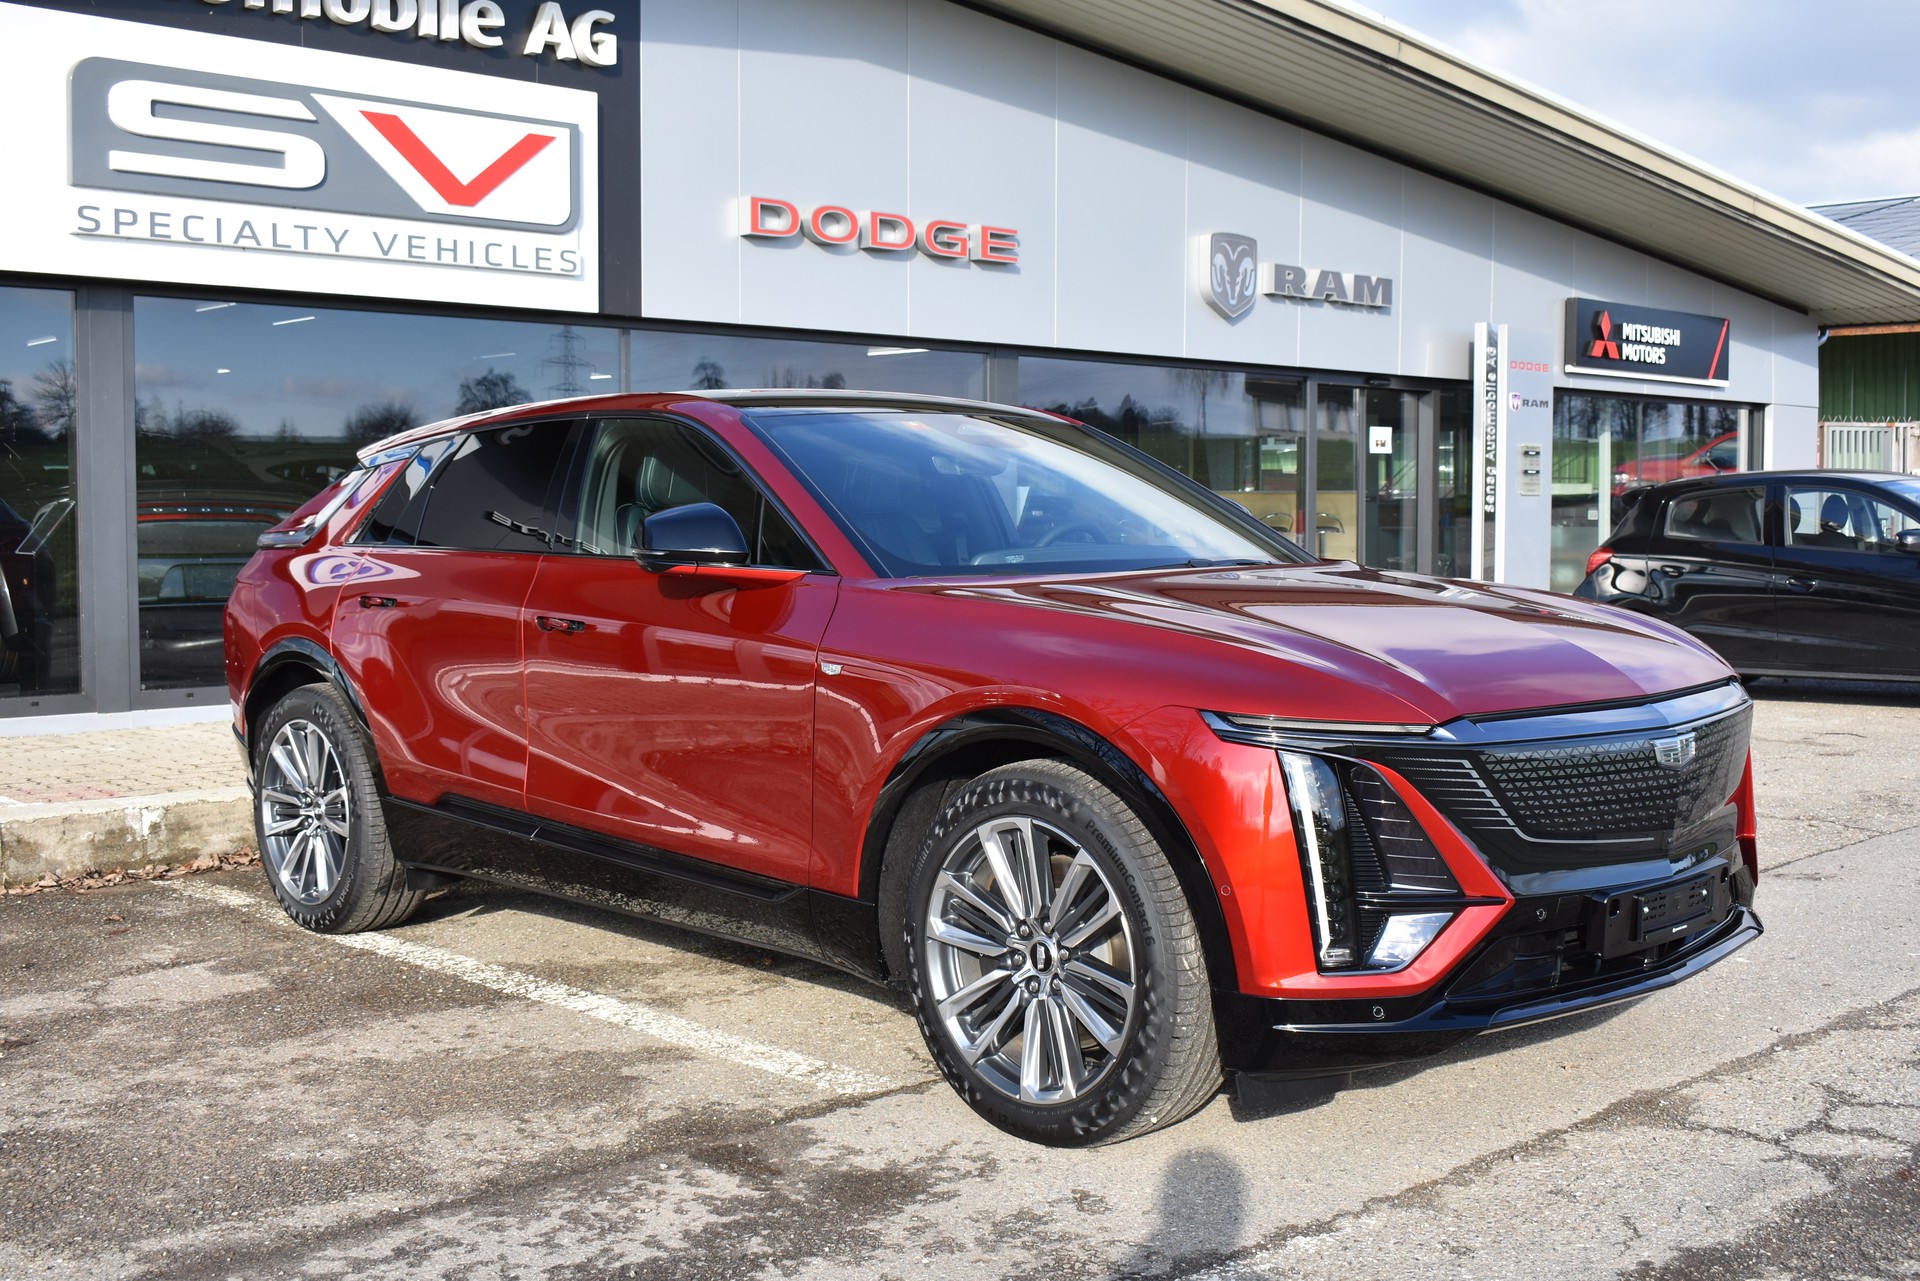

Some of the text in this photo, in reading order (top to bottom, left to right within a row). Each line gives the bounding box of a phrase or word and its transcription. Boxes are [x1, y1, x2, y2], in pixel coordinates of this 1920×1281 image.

[524, 1, 618, 66] AG
[76, 204, 578, 273] SPECIALTY VEHICLES
[748, 196, 1019, 264] DODGE
[1270, 263, 1393, 307] RAM
[1622, 322, 1680, 346] MITSUBISHI
[1622, 343, 1666, 365] MOTORS
[1510, 360, 1549, 373] DODGE
[1522, 399, 1549, 409] RAM
[1084, 819, 1156, 947] PremiumContact 6
